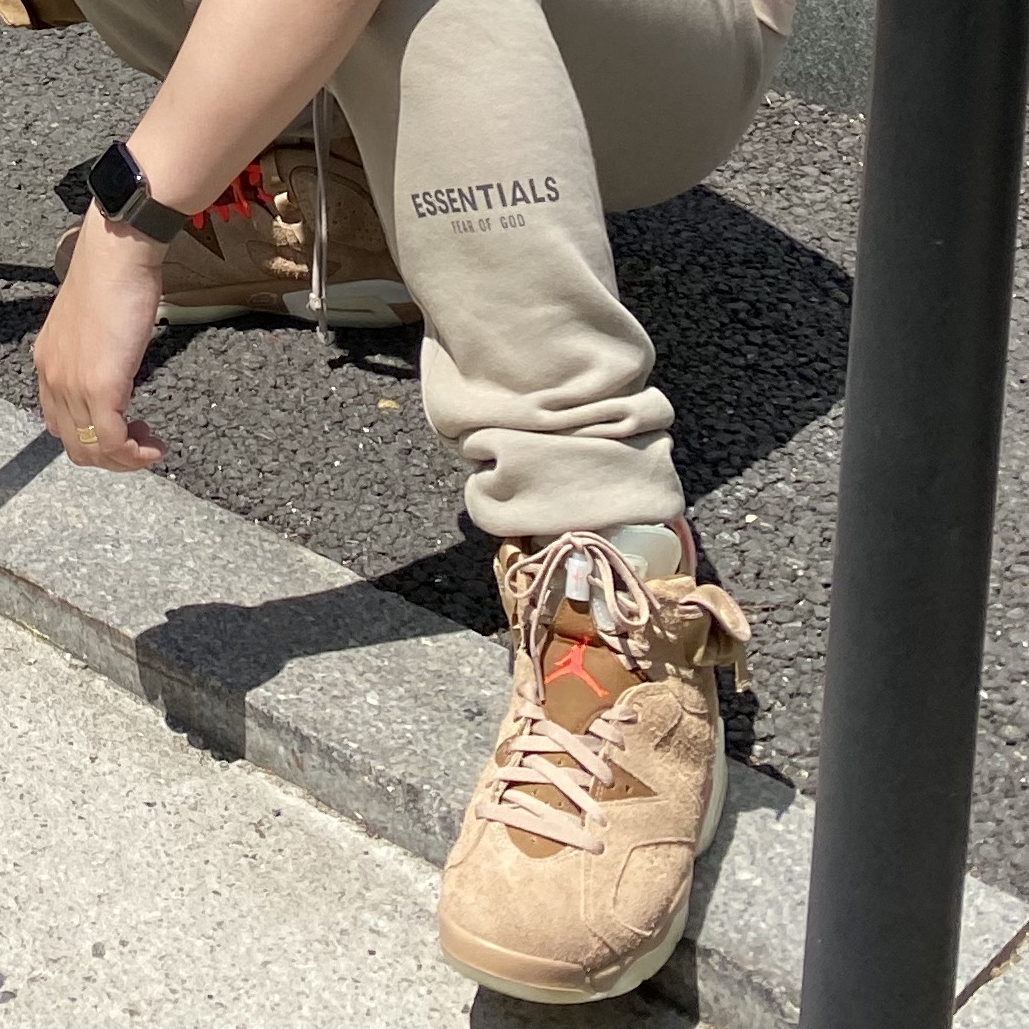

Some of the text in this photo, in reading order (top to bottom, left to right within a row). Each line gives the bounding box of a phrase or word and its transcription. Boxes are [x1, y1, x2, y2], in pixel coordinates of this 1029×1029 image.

[411, 176, 560, 218] ESSENTIALS
[451, 213, 526, 234] FEAR OF GOD
